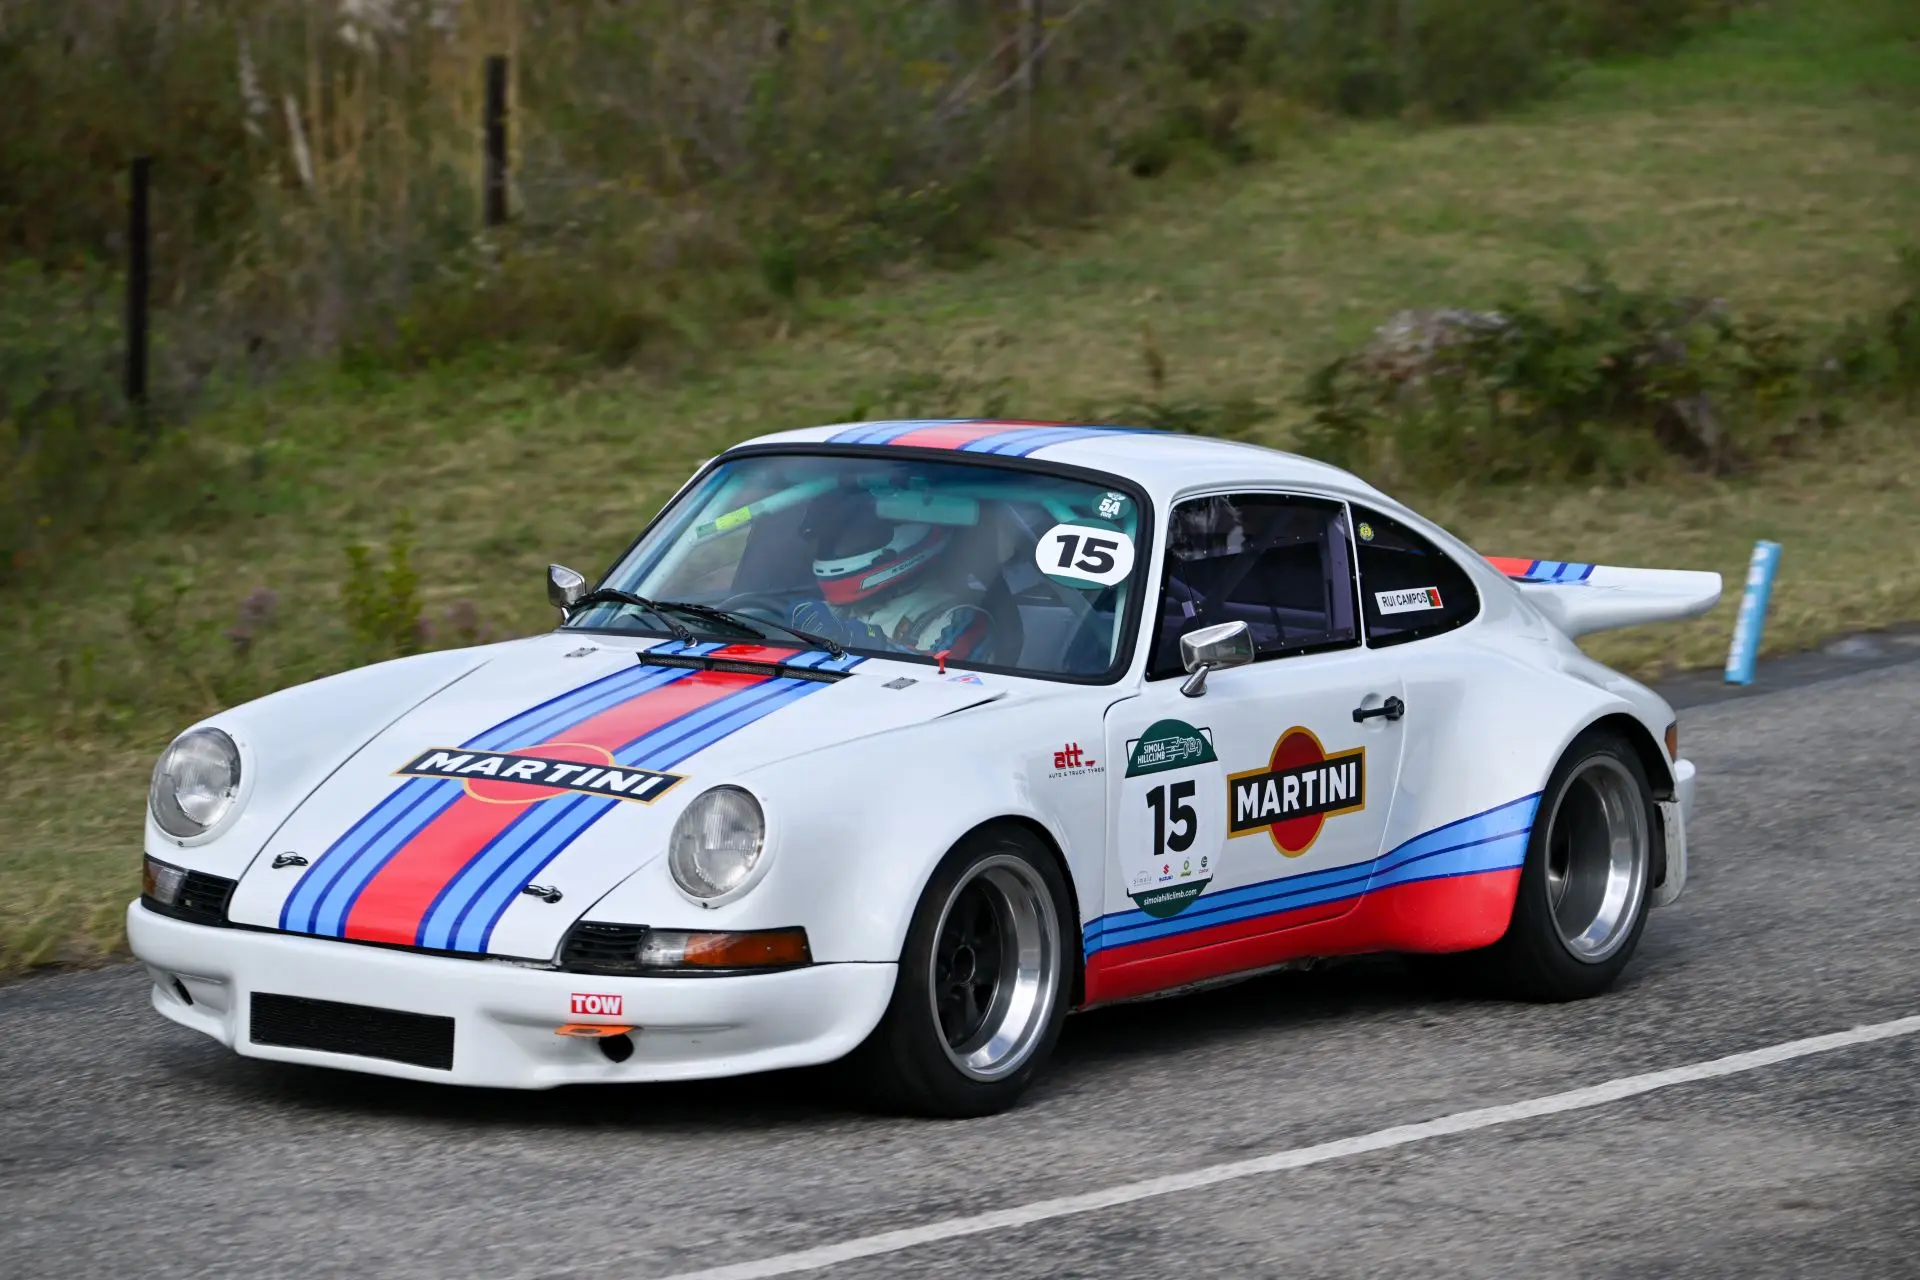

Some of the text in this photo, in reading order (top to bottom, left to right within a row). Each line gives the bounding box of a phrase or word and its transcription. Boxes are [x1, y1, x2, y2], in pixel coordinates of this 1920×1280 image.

[1099, 498, 1120, 515] 5A
[1057, 535, 1119, 574] 15
[1381, 592, 1428, 607] RUI CAMPOS
[1143, 742, 1165, 754] SIMOLA
[1137, 751, 1166, 765] HILLCLIMB
[415, 751, 665, 796] MARTINI
[1237, 762, 1356, 822] MARTINI
[1146, 779, 1197, 856] 15
[1143, 888, 1197, 906] simolahillclimb.com
[572, 995, 621, 1015] TOW
